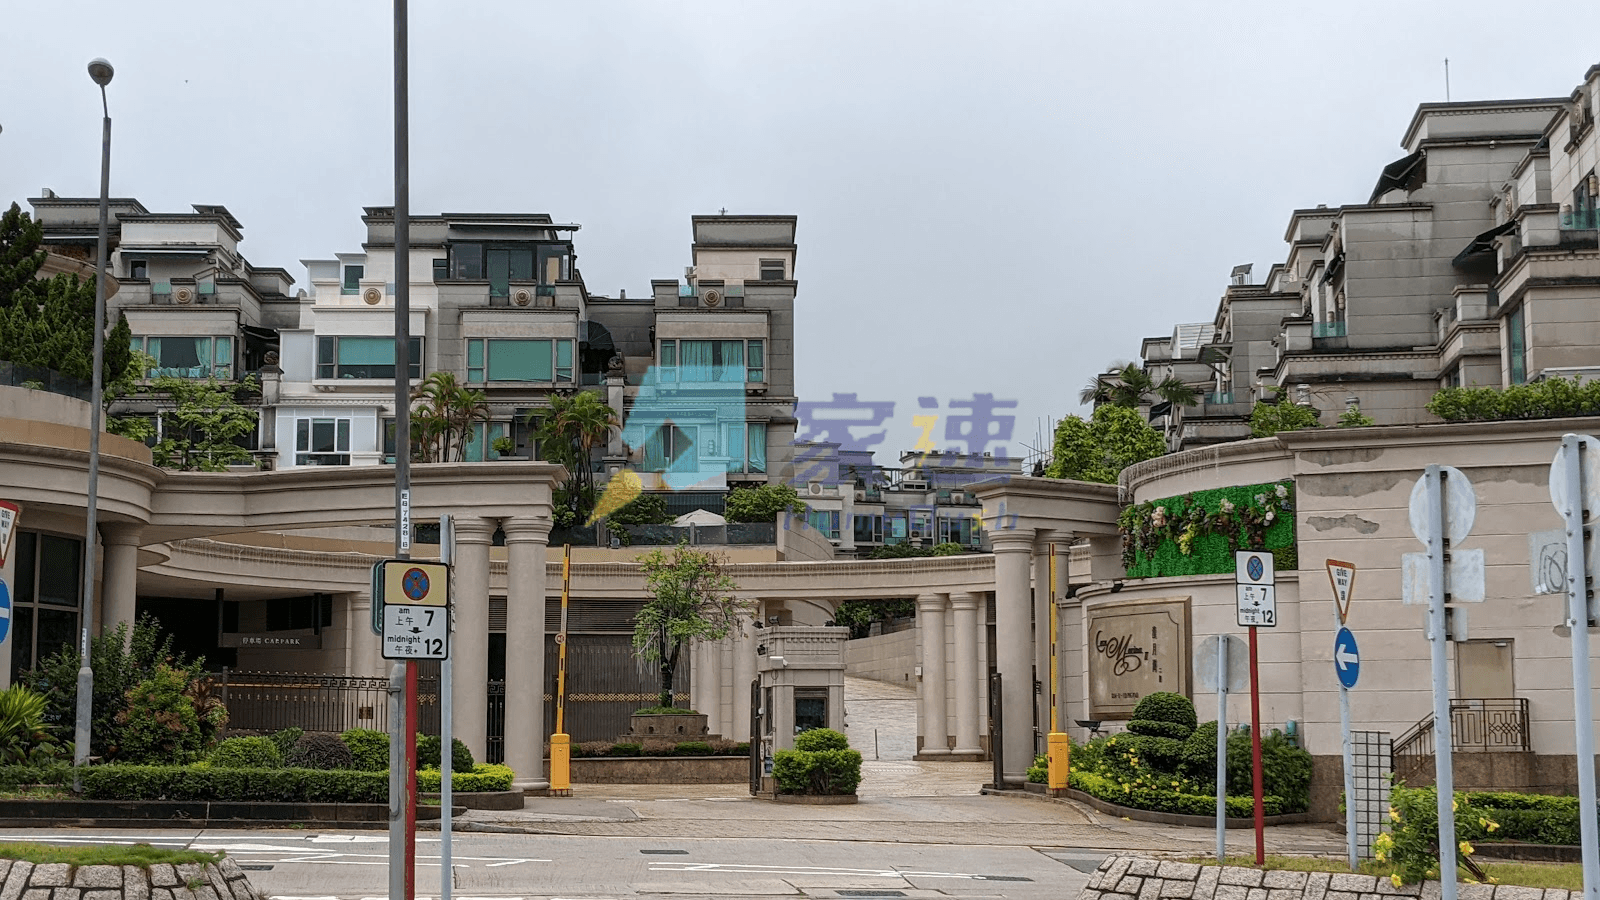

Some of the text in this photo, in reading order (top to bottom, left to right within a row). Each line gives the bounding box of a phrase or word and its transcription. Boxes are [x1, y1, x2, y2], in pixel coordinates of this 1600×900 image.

[1260, 588, 1267, 601] 7
[395, 616, 414, 626] 上午
[424, 610, 434, 626] 7
[1261, 610, 1273, 623] 12
[387, 635, 443, 655] midnight 12
[394, 645, 413, 655] 午夜
